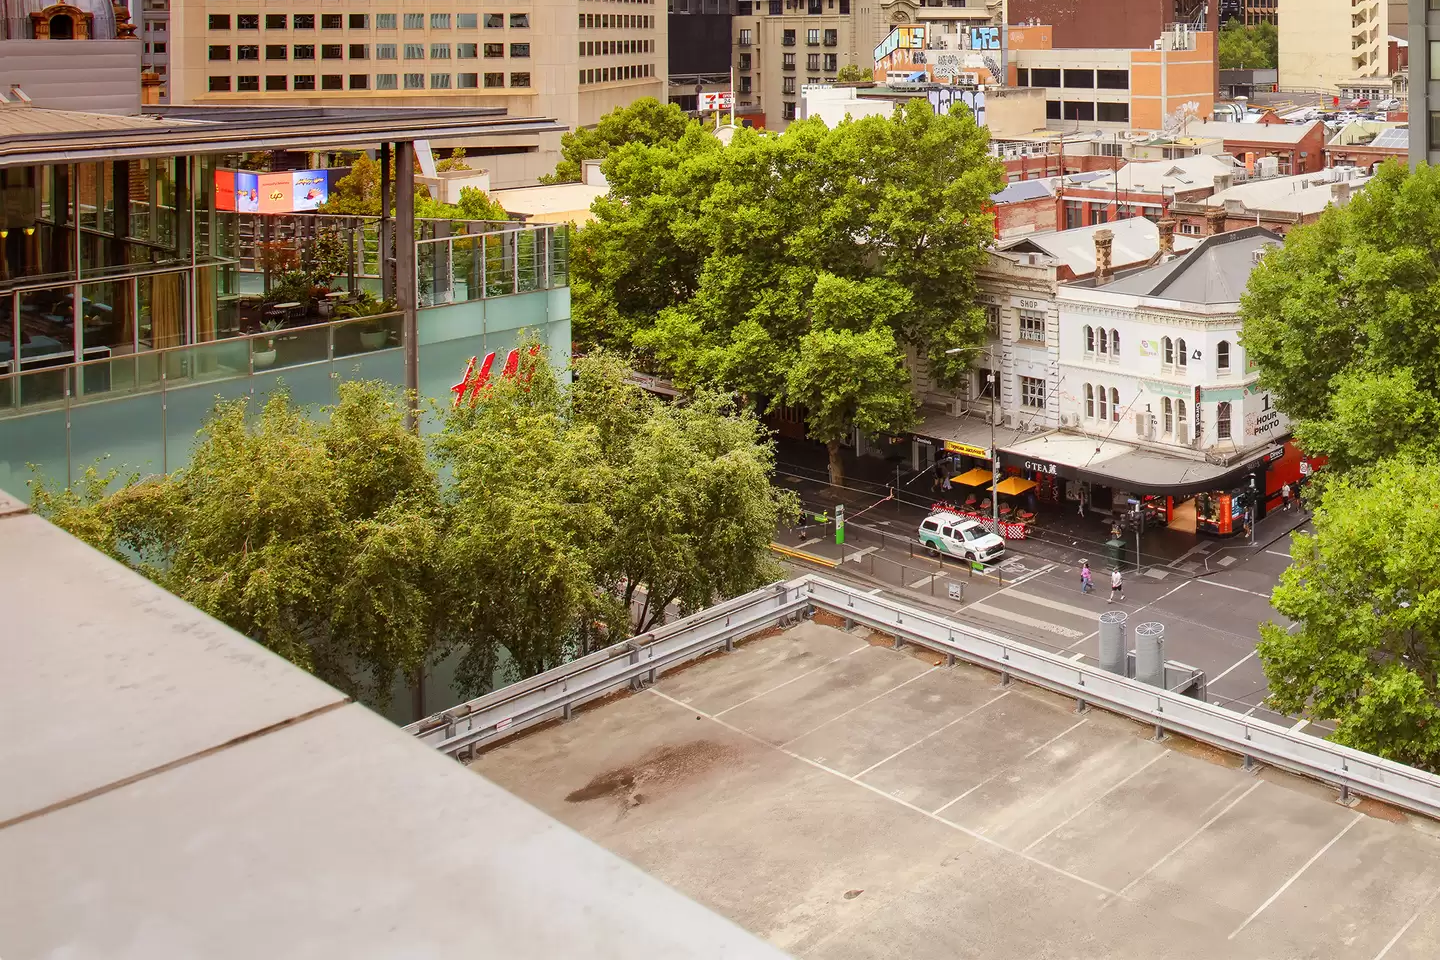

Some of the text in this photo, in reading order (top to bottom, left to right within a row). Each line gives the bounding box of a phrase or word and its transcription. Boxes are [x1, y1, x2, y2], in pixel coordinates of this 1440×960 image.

[971, 27, 1000, 49] LFC
[269, 191, 283, 201] up
[1020, 300, 1038, 309] SHOP
[1262, 394, 1271, 412] 1
[1256, 411, 1277, 425] HOUR
[1254, 419, 1280, 436] PHOTO
[1032, 463, 1048, 473] TEA
